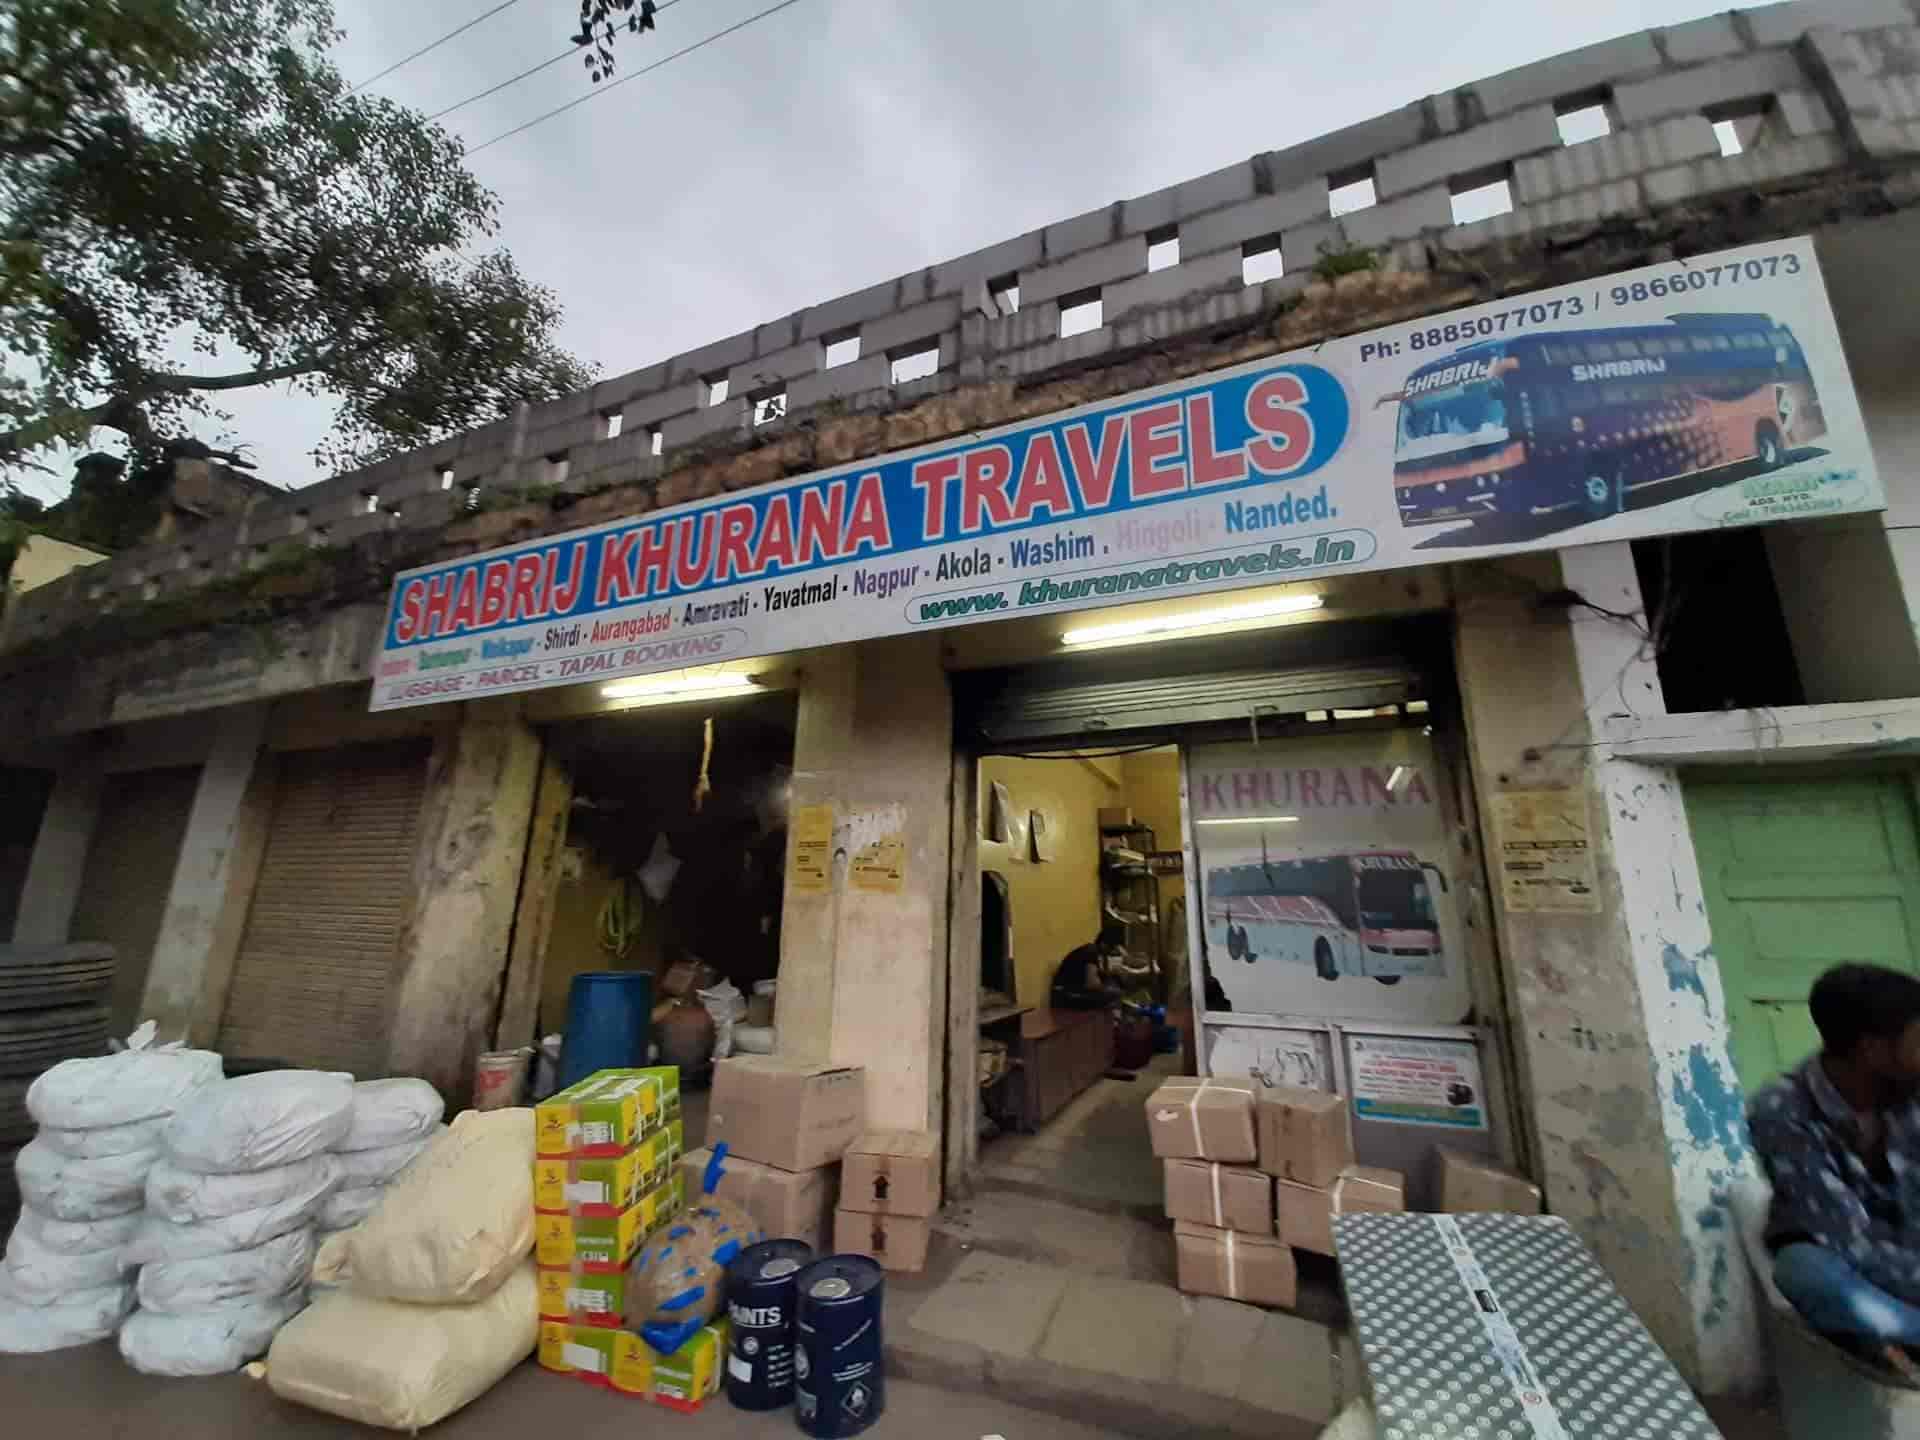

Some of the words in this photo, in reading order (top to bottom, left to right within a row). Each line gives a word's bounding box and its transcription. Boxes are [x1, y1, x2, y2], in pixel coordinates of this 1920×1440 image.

[1360, 341, 1400, 363] Ph:
[1410, 296, 1584, 351] 8885077073
[1610, 253, 1801, 306] 9866077073
[397, 543, 590, 644] SHABRIJ
[597, 472, 892, 607] KHURANA
[913, 372, 1314, 538] TRAVELS
[544, 623, 581, 651] Shirdi
[591, 607, 672, 644] Aurangabad
[682, 592, 749, 627] Amravati
[763, 574, 839, 612] Yavatmal
[853, 564, 919, 599] Nagpur
[936, 548, 991, 582] Akola
[1010, 530, 1095, 569] Washim
[1116, 508, 1198, 550] Hingoli
[1225, 485, 1337, 534] Nanded.
[480, 663, 540, 686] PARCEL
[559, 651, 617, 677] TAPAL
[623, 633, 726, 667] BOOKING
[1200, 764, 1432, 814] KHURANA
